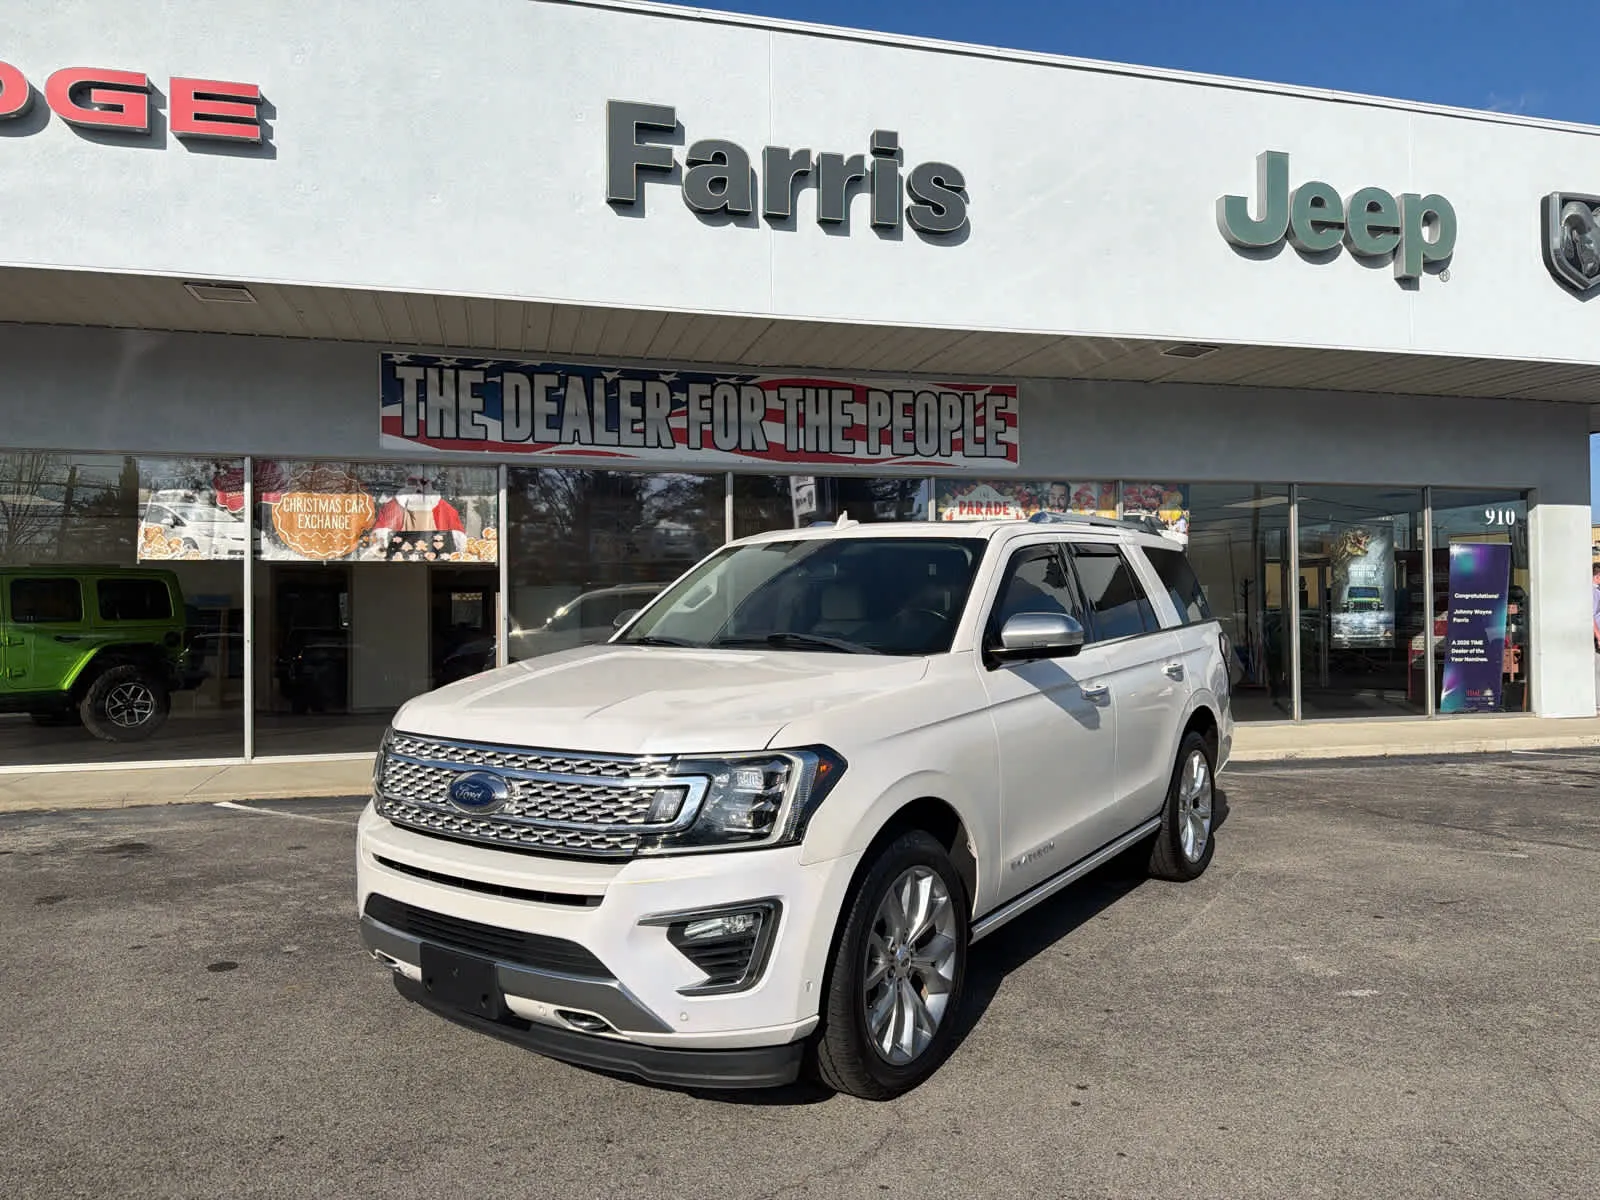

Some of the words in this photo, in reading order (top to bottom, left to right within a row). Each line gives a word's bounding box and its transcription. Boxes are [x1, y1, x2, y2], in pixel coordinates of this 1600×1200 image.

[0, 60, 262, 144] GE
[605, 98, 967, 235] Farris
[1215, 149, 1458, 289] Jeep
[395, 363, 489, 441] THE
[501, 370, 676, 450] DEALER
[686, 380, 769, 453] FOR
[776, 384, 856, 455] THE
[866, 388, 1009, 459] PEOPLE
[282, 497, 342, 514] CHRISTMAS
[344, 499, 366, 514] CAR
[958, 500, 1011, 516] PARADE
[297, 514, 351, 530] EXCHANGE
[1485, 507, 1516, 526] 910
[455, 782, 485, 800] Ford
